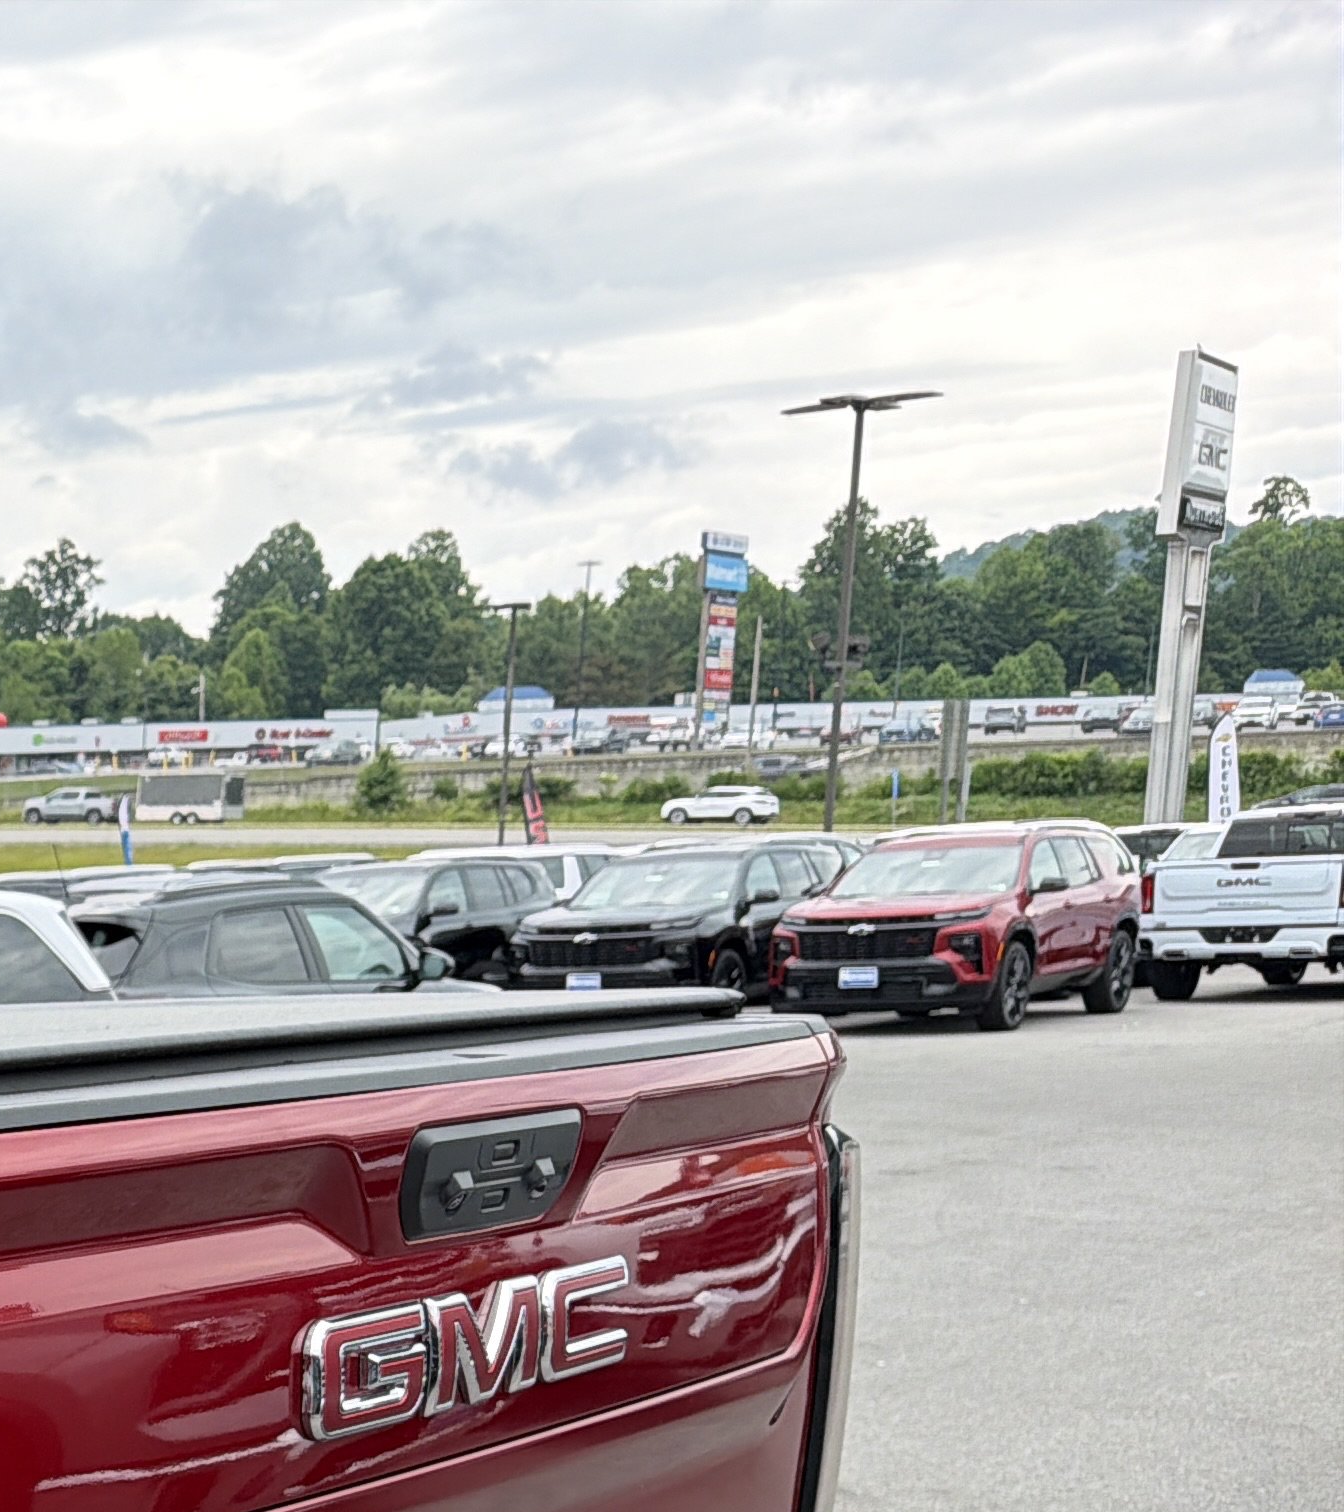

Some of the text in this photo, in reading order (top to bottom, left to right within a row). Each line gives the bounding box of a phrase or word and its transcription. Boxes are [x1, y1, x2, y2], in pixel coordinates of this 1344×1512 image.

[1197, 441, 1228, 471] GMC
[1216, 877, 1272, 888] GMC
[290, 1254, 630, 1442] GMC
